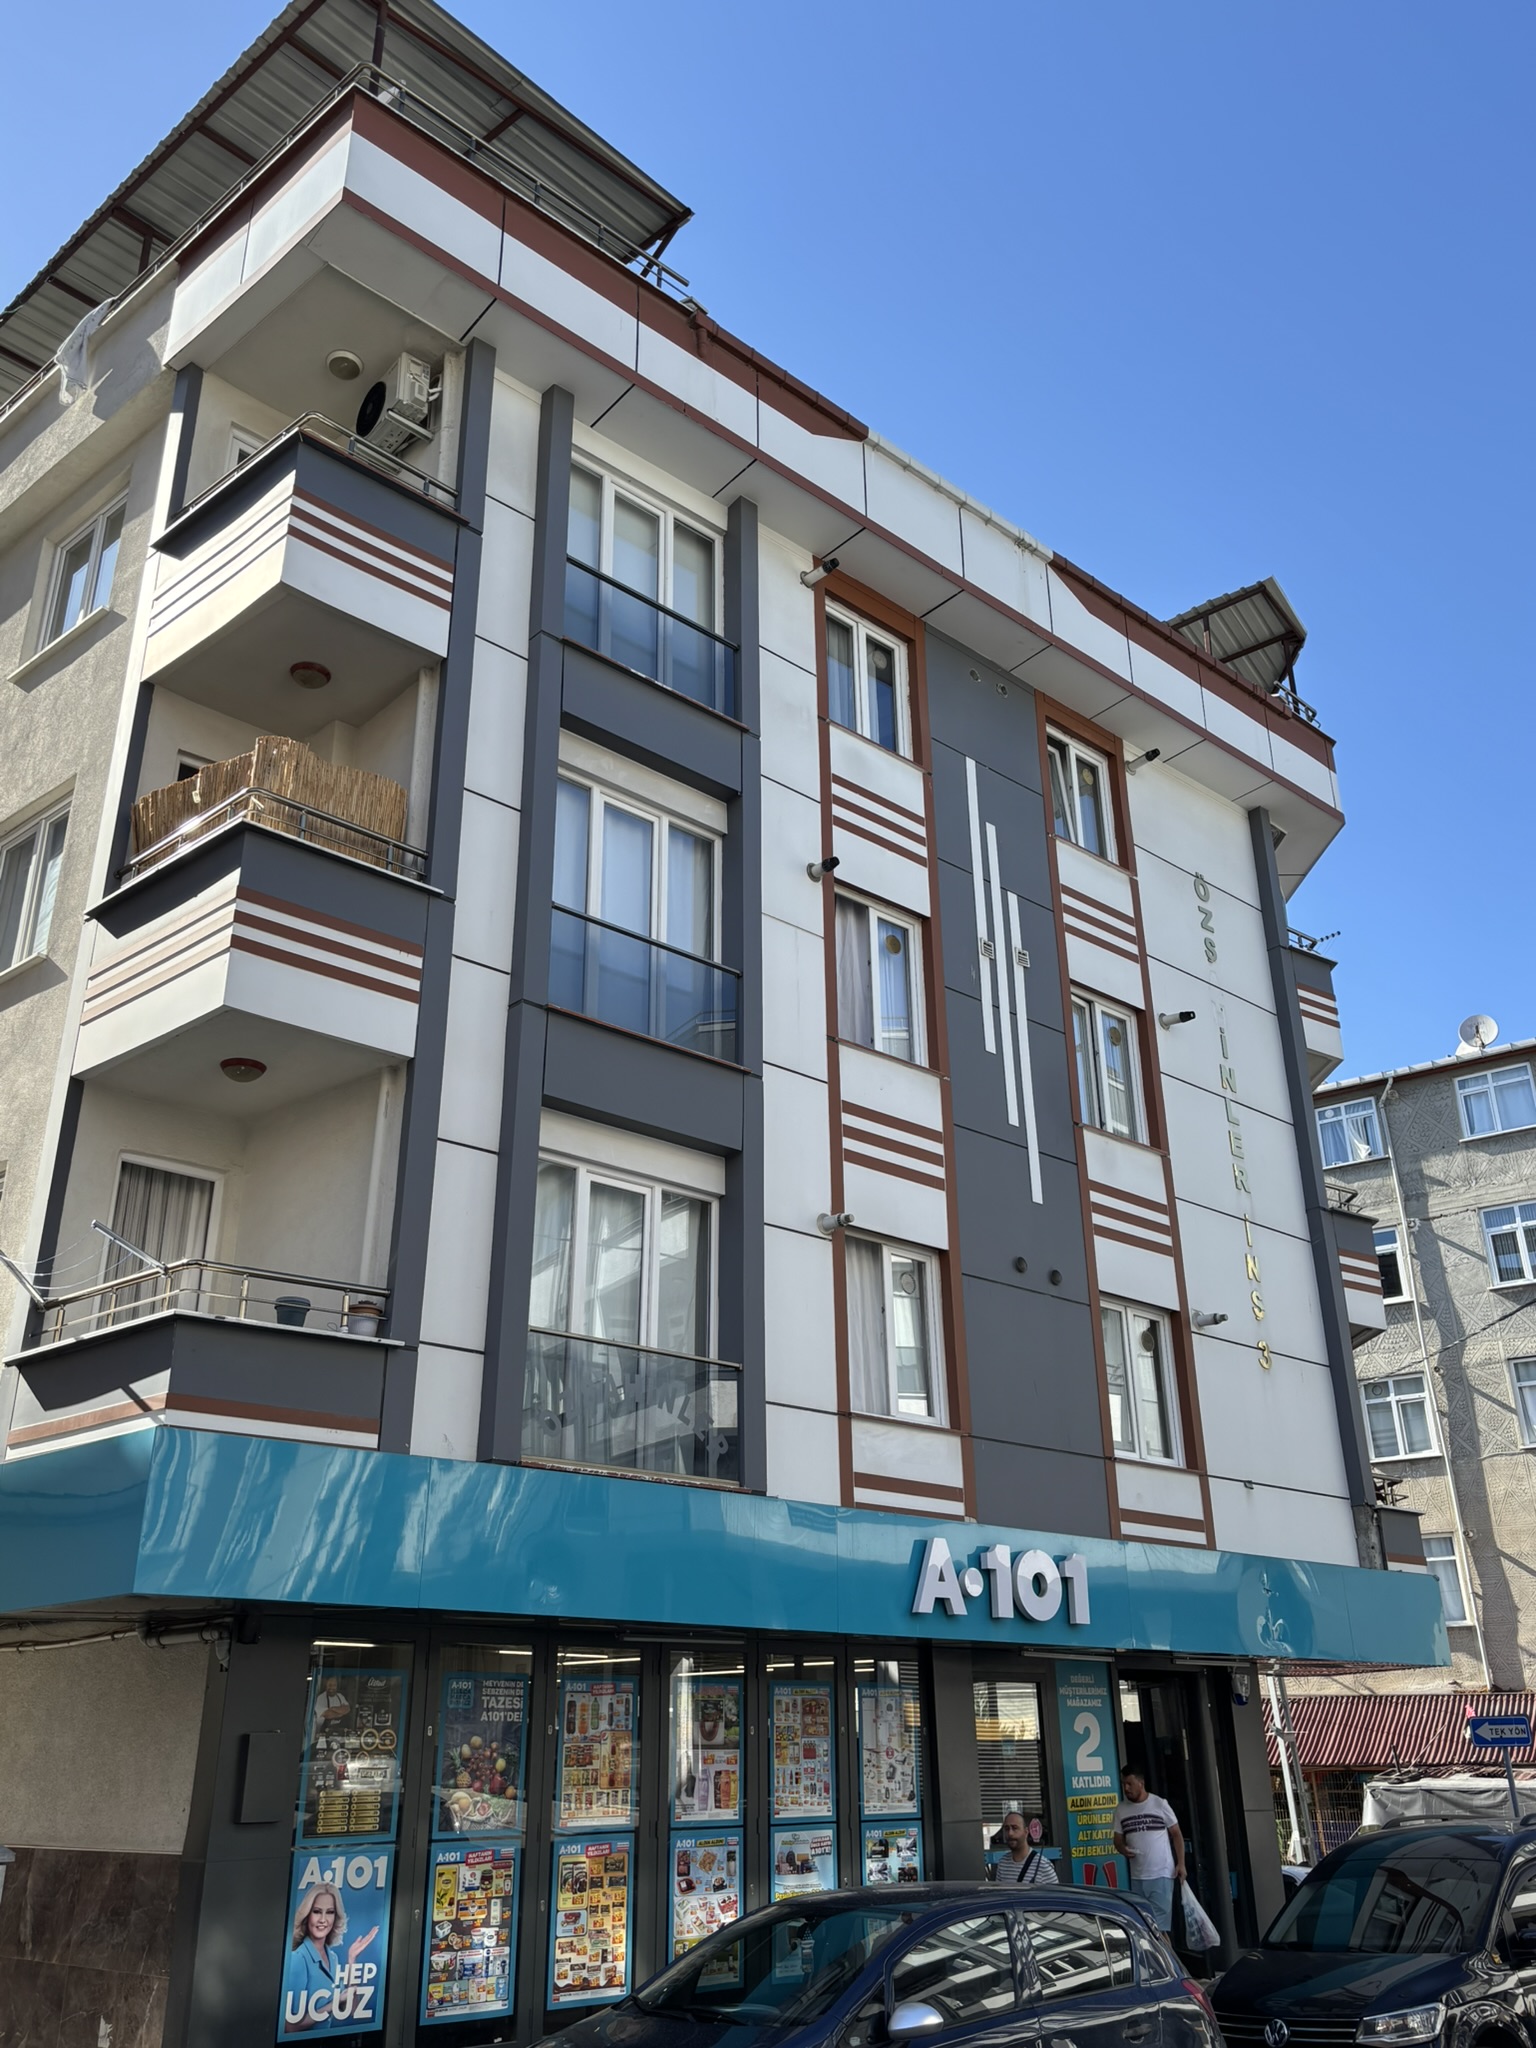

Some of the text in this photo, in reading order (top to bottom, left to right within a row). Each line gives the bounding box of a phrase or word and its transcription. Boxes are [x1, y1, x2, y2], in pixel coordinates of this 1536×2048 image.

[1070, 1673, 1095, 1684] DEĞERLİ
[1059, 1685, 1107, 1697] MÜŞTERİLERİMİZ
[481, 1696, 523, 1709] TAZESİ
[1066, 1696, 1102, 1707] MAĞAZAMIZ
[480, 1711, 523, 1722] A101'DE!
[1489, 1726, 1526, 1736] TEK YÖN
[1072, 1711, 1104, 1773] 2
[1071, 1775, 1112, 1789] KATLIDIR
[1070, 1794, 1117, 1809] ALDIN ALDIN!
[1077, 1811, 1114, 1825] ÜRÜNLERİ
[1078, 1831, 1092, 1841] ALT
[1071, 1842, 1119, 1858] SİZİ BEKLİYO
[334, 1962, 377, 1985] HEP
[285, 1986, 374, 2024] UCUZ
